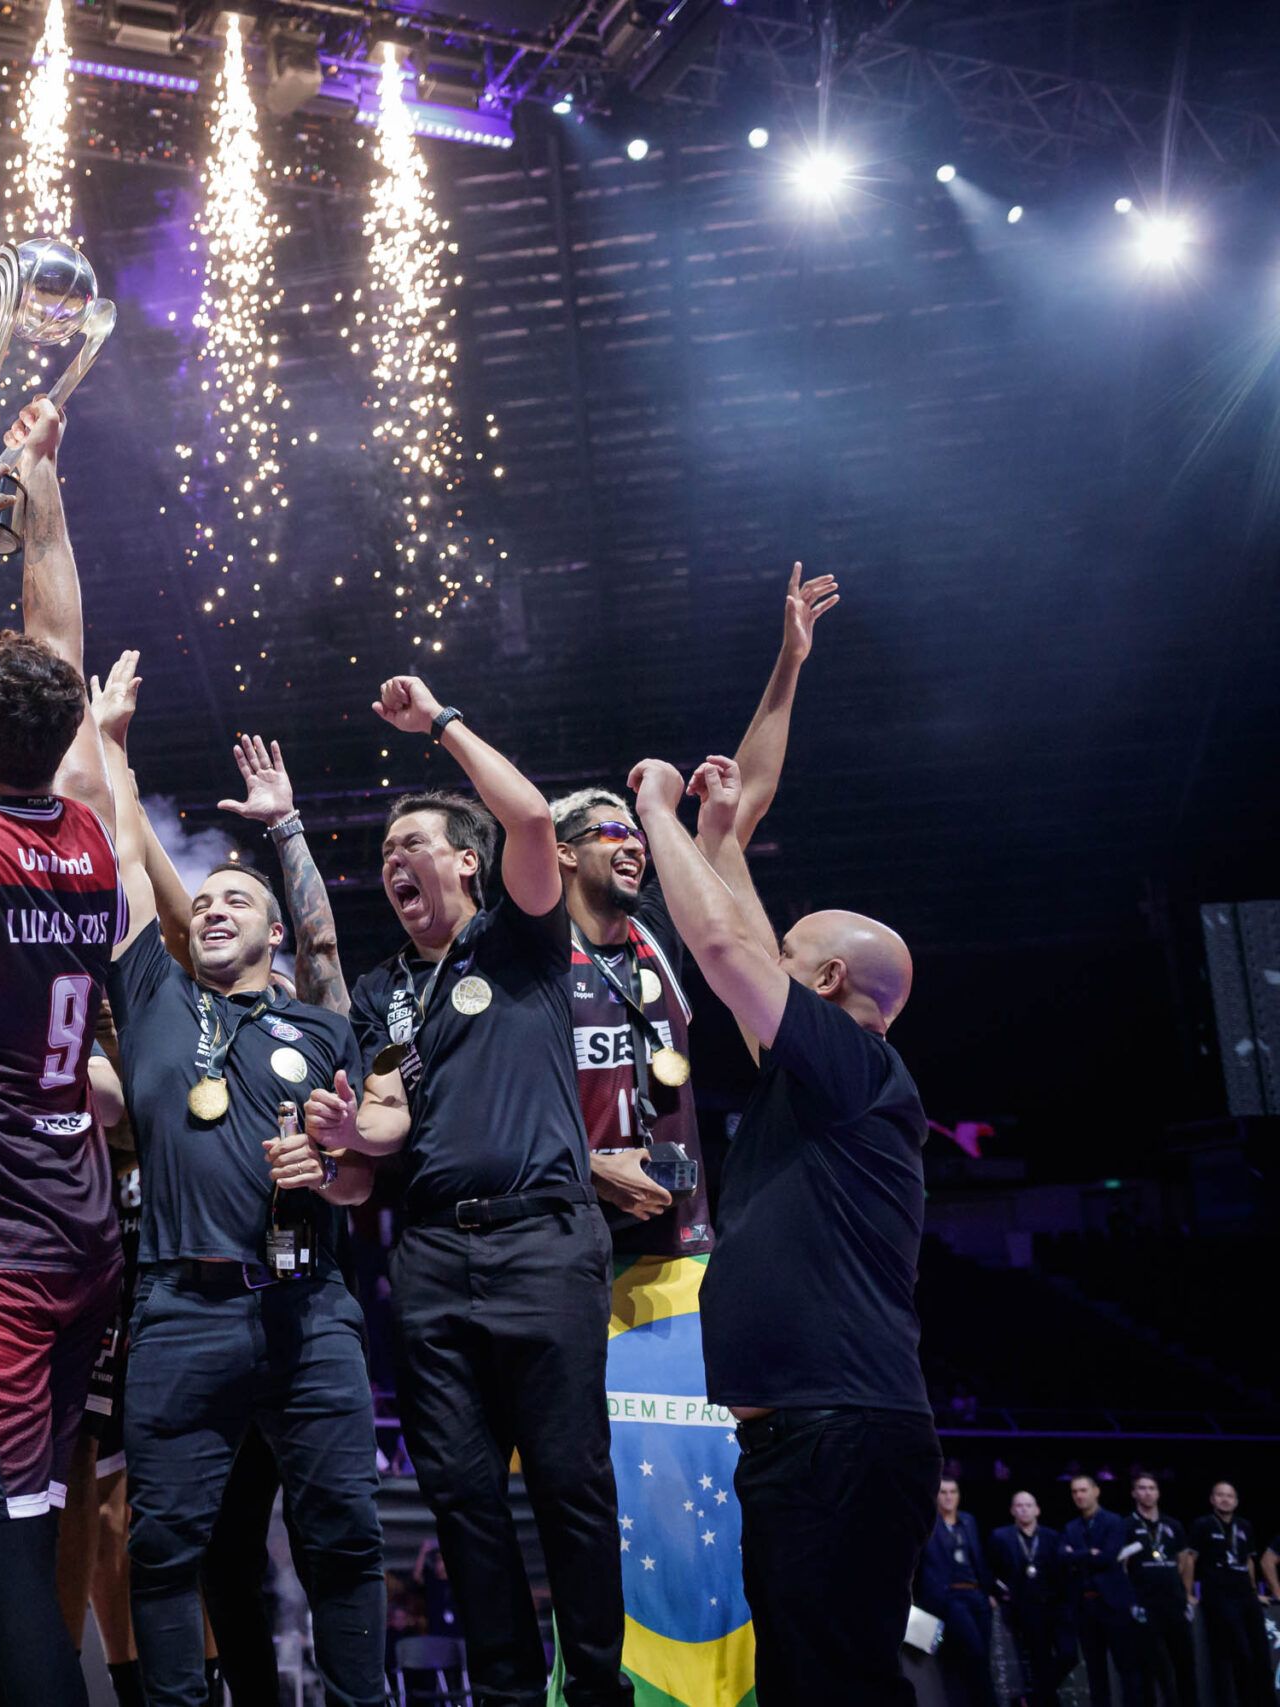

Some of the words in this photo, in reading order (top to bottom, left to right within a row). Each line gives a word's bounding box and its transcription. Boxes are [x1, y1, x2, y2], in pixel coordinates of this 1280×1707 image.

[7, 908, 76, 944] LUCAS
[39, 974, 92, 1089] 9
[608, 1398, 656, 1418] DEM
[666, 1401, 677, 1420] E
[685, 1402, 730, 1422] PRO
